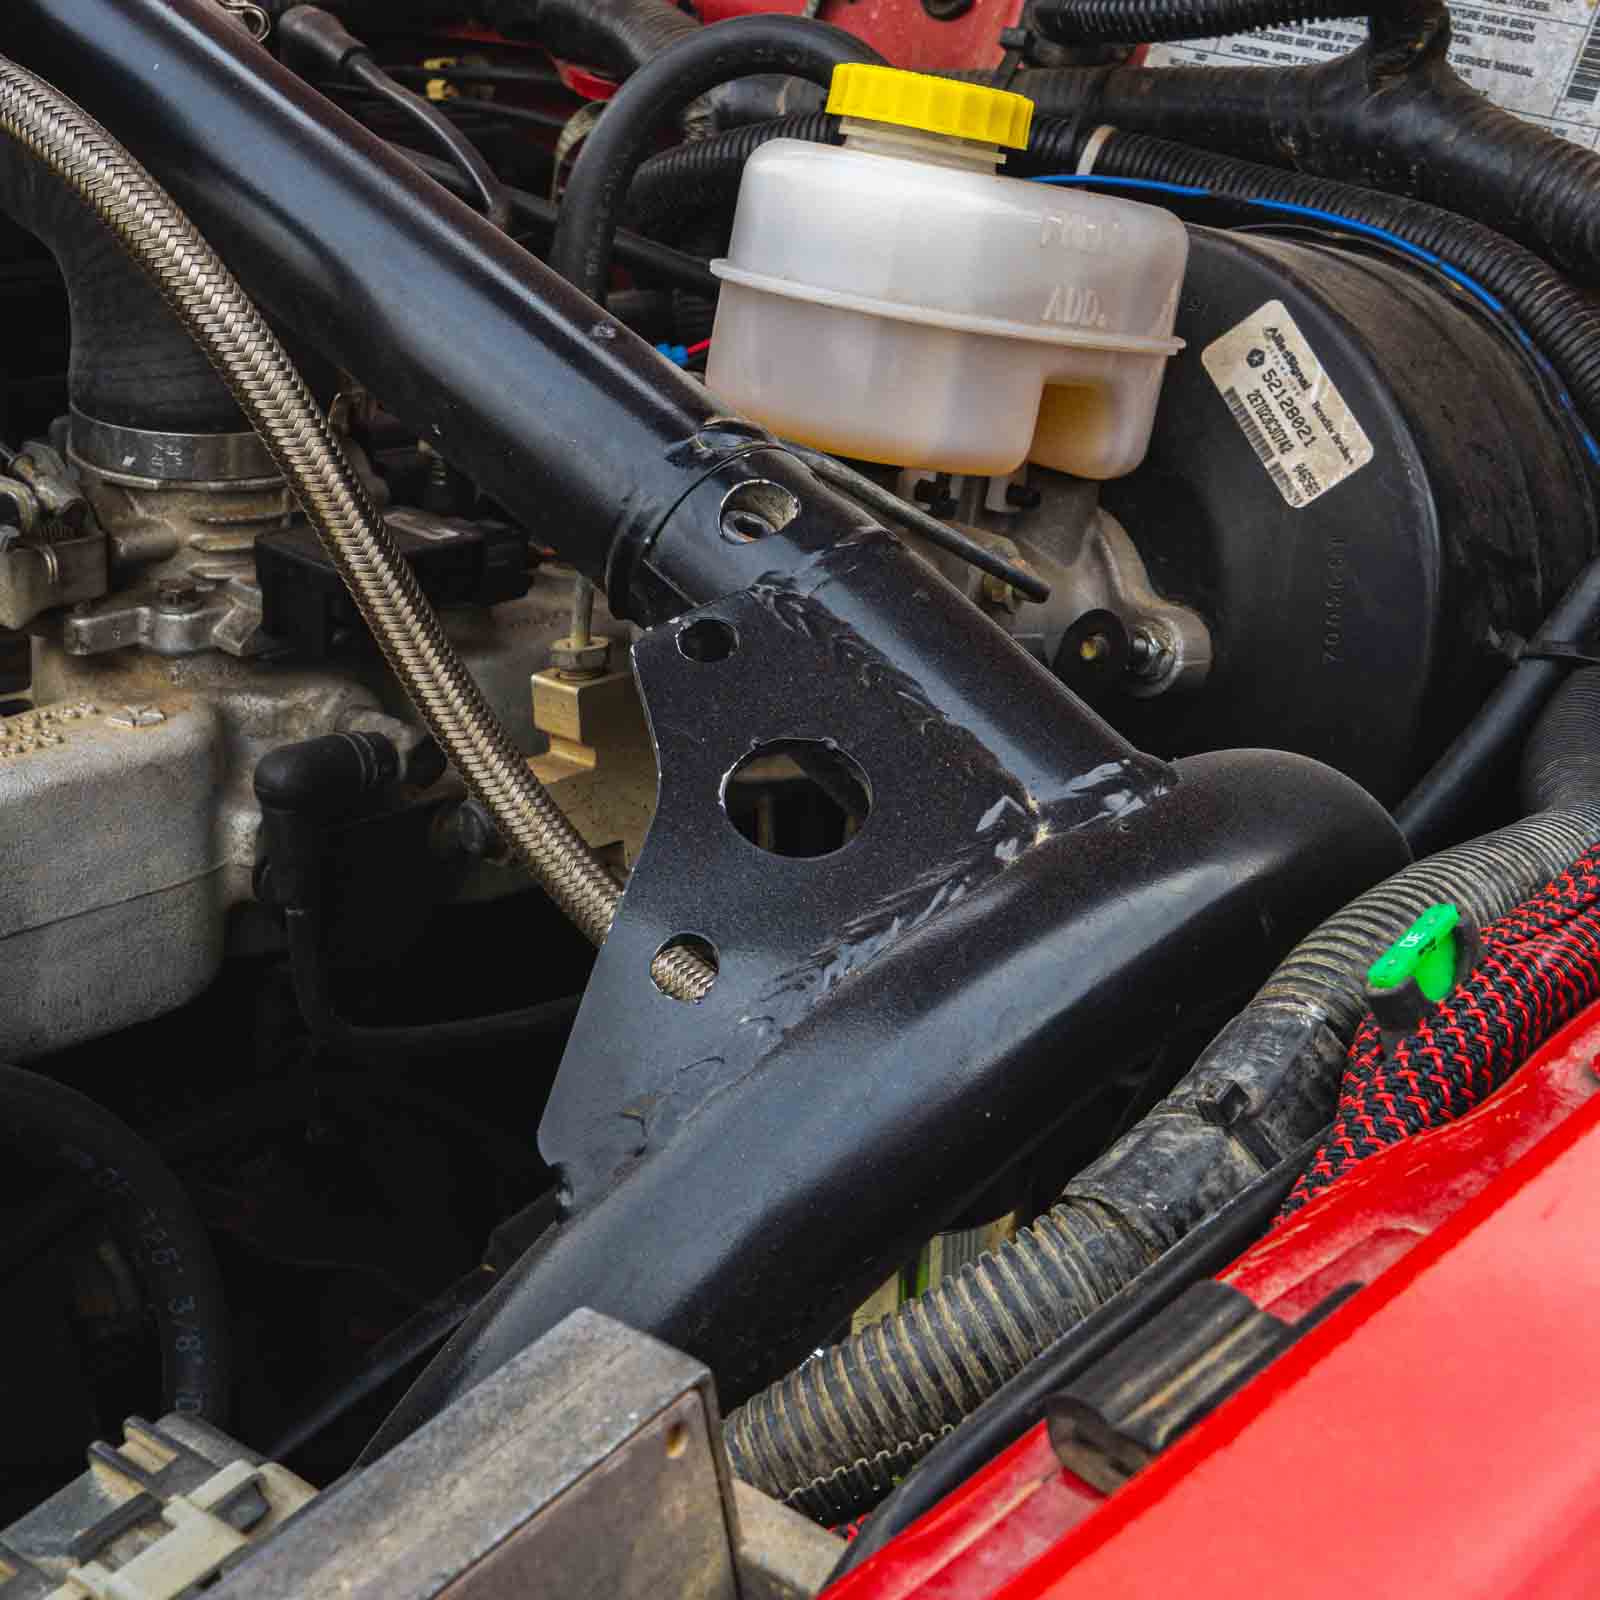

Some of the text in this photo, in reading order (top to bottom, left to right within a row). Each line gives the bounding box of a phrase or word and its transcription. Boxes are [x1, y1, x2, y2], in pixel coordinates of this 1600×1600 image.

[1510, 18, 1537, 31] BEEN
[1453, 53, 1493, 70] SERVICE
[1493, 60, 1535, 78] MANUAL
[1260, 367, 1319, 449] 52128021
